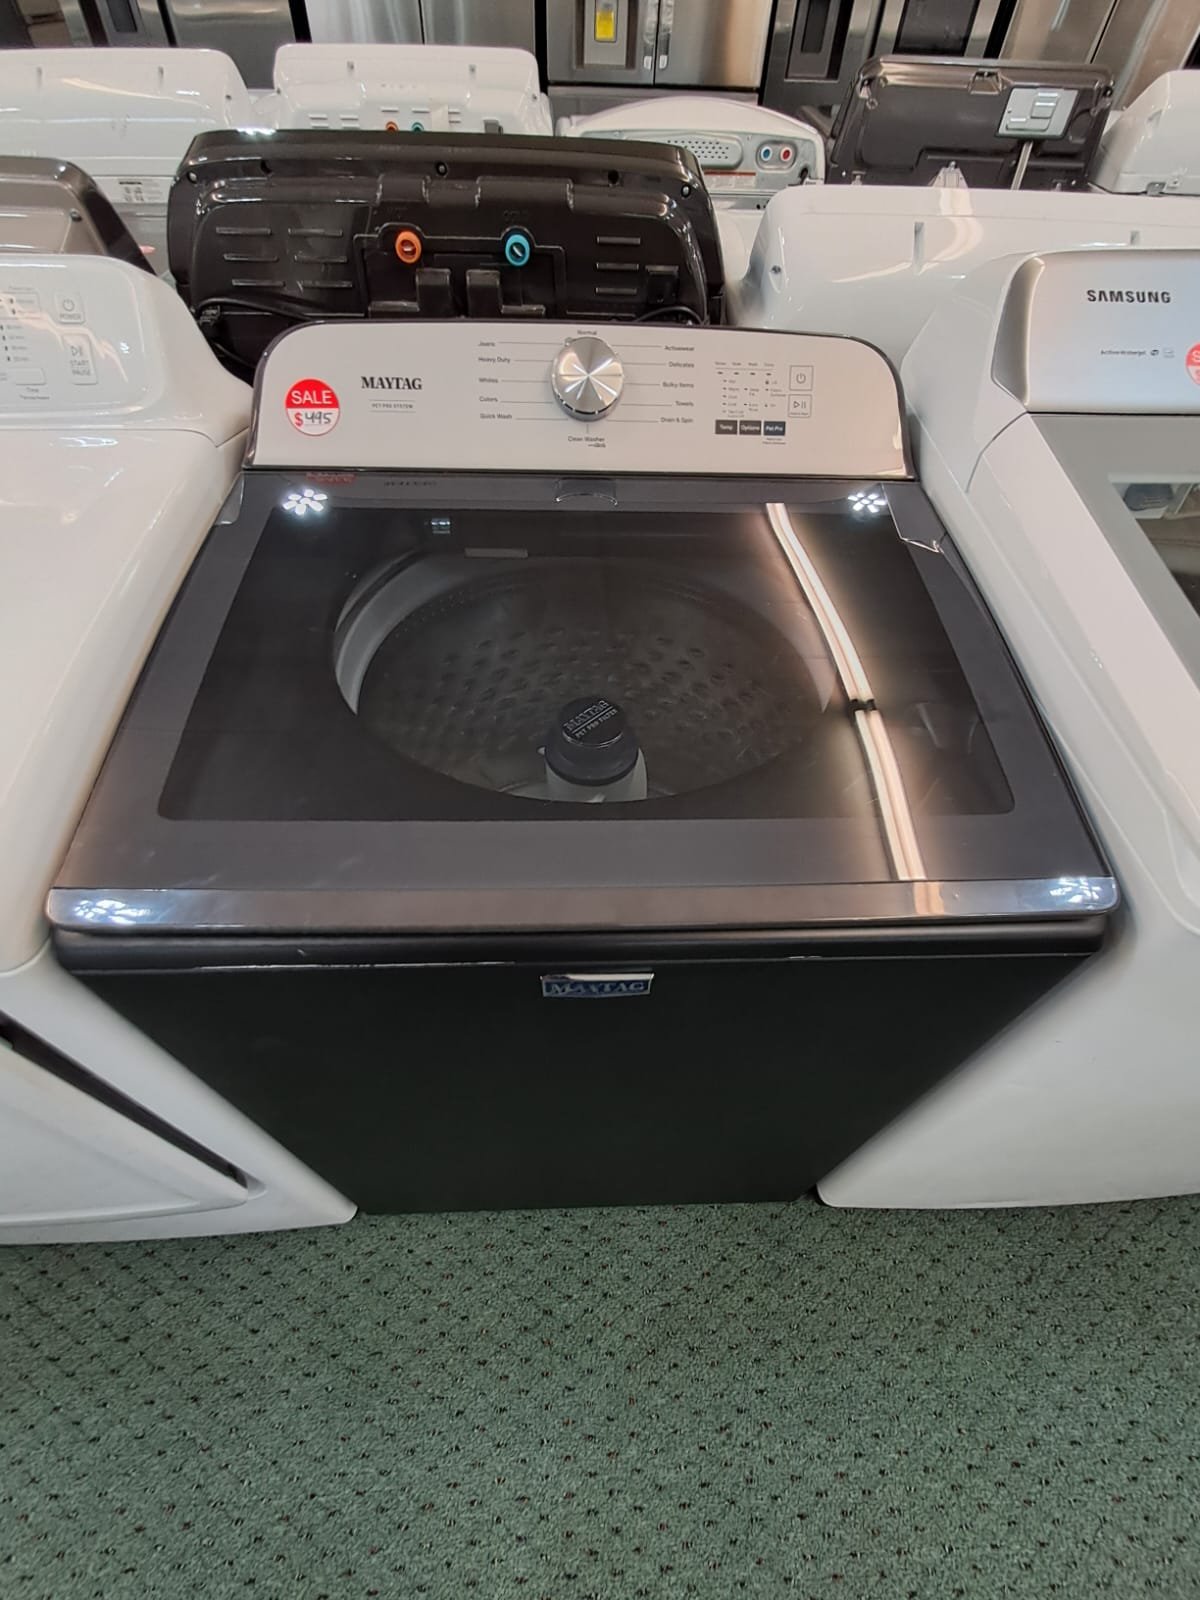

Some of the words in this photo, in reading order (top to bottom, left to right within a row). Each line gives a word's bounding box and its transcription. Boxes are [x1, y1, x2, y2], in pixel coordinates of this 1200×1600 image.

[1086, 289, 1171, 304] SAMSUNG
[360, 376, 423, 391] MAYTAG
[291, 389, 333, 405] SALE
[550, 982, 645, 994] MAYTAG
